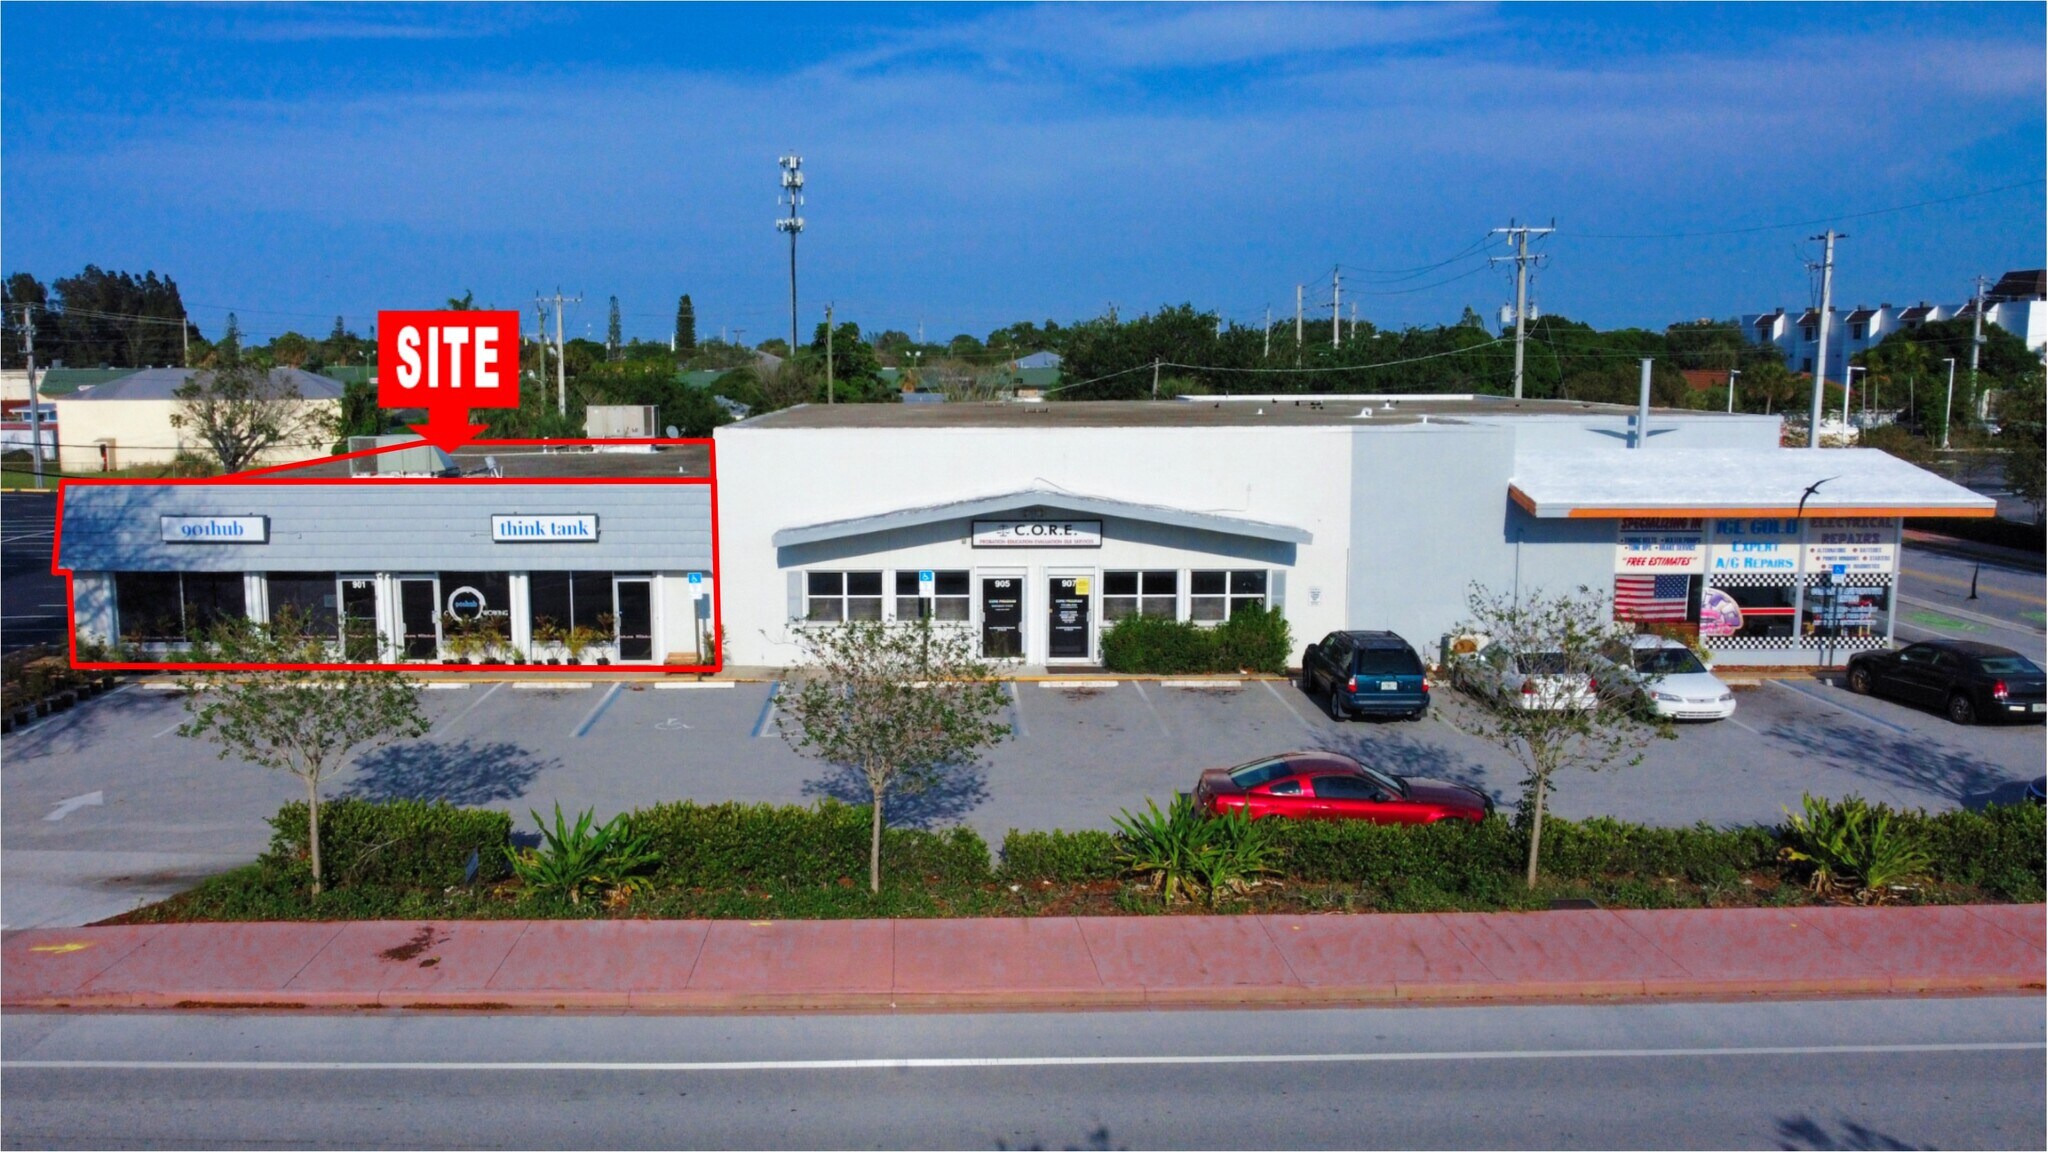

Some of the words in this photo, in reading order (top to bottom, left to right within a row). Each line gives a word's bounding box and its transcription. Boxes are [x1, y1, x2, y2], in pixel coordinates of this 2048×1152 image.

[500, 520, 545, 536] think
[551, 520, 588, 536] tank
[1809, 518, 1894, 528] ELECTRICAL
[181, 520, 244, 538] 901hub
[1014, 524, 1078, 536] C.O.R.E.
[1821, 533, 1881, 545] REPAIRS
[352, 581, 366, 589] 901
[994, 580, 1011, 588] 905
[1061, 580, 1076, 588] 907
